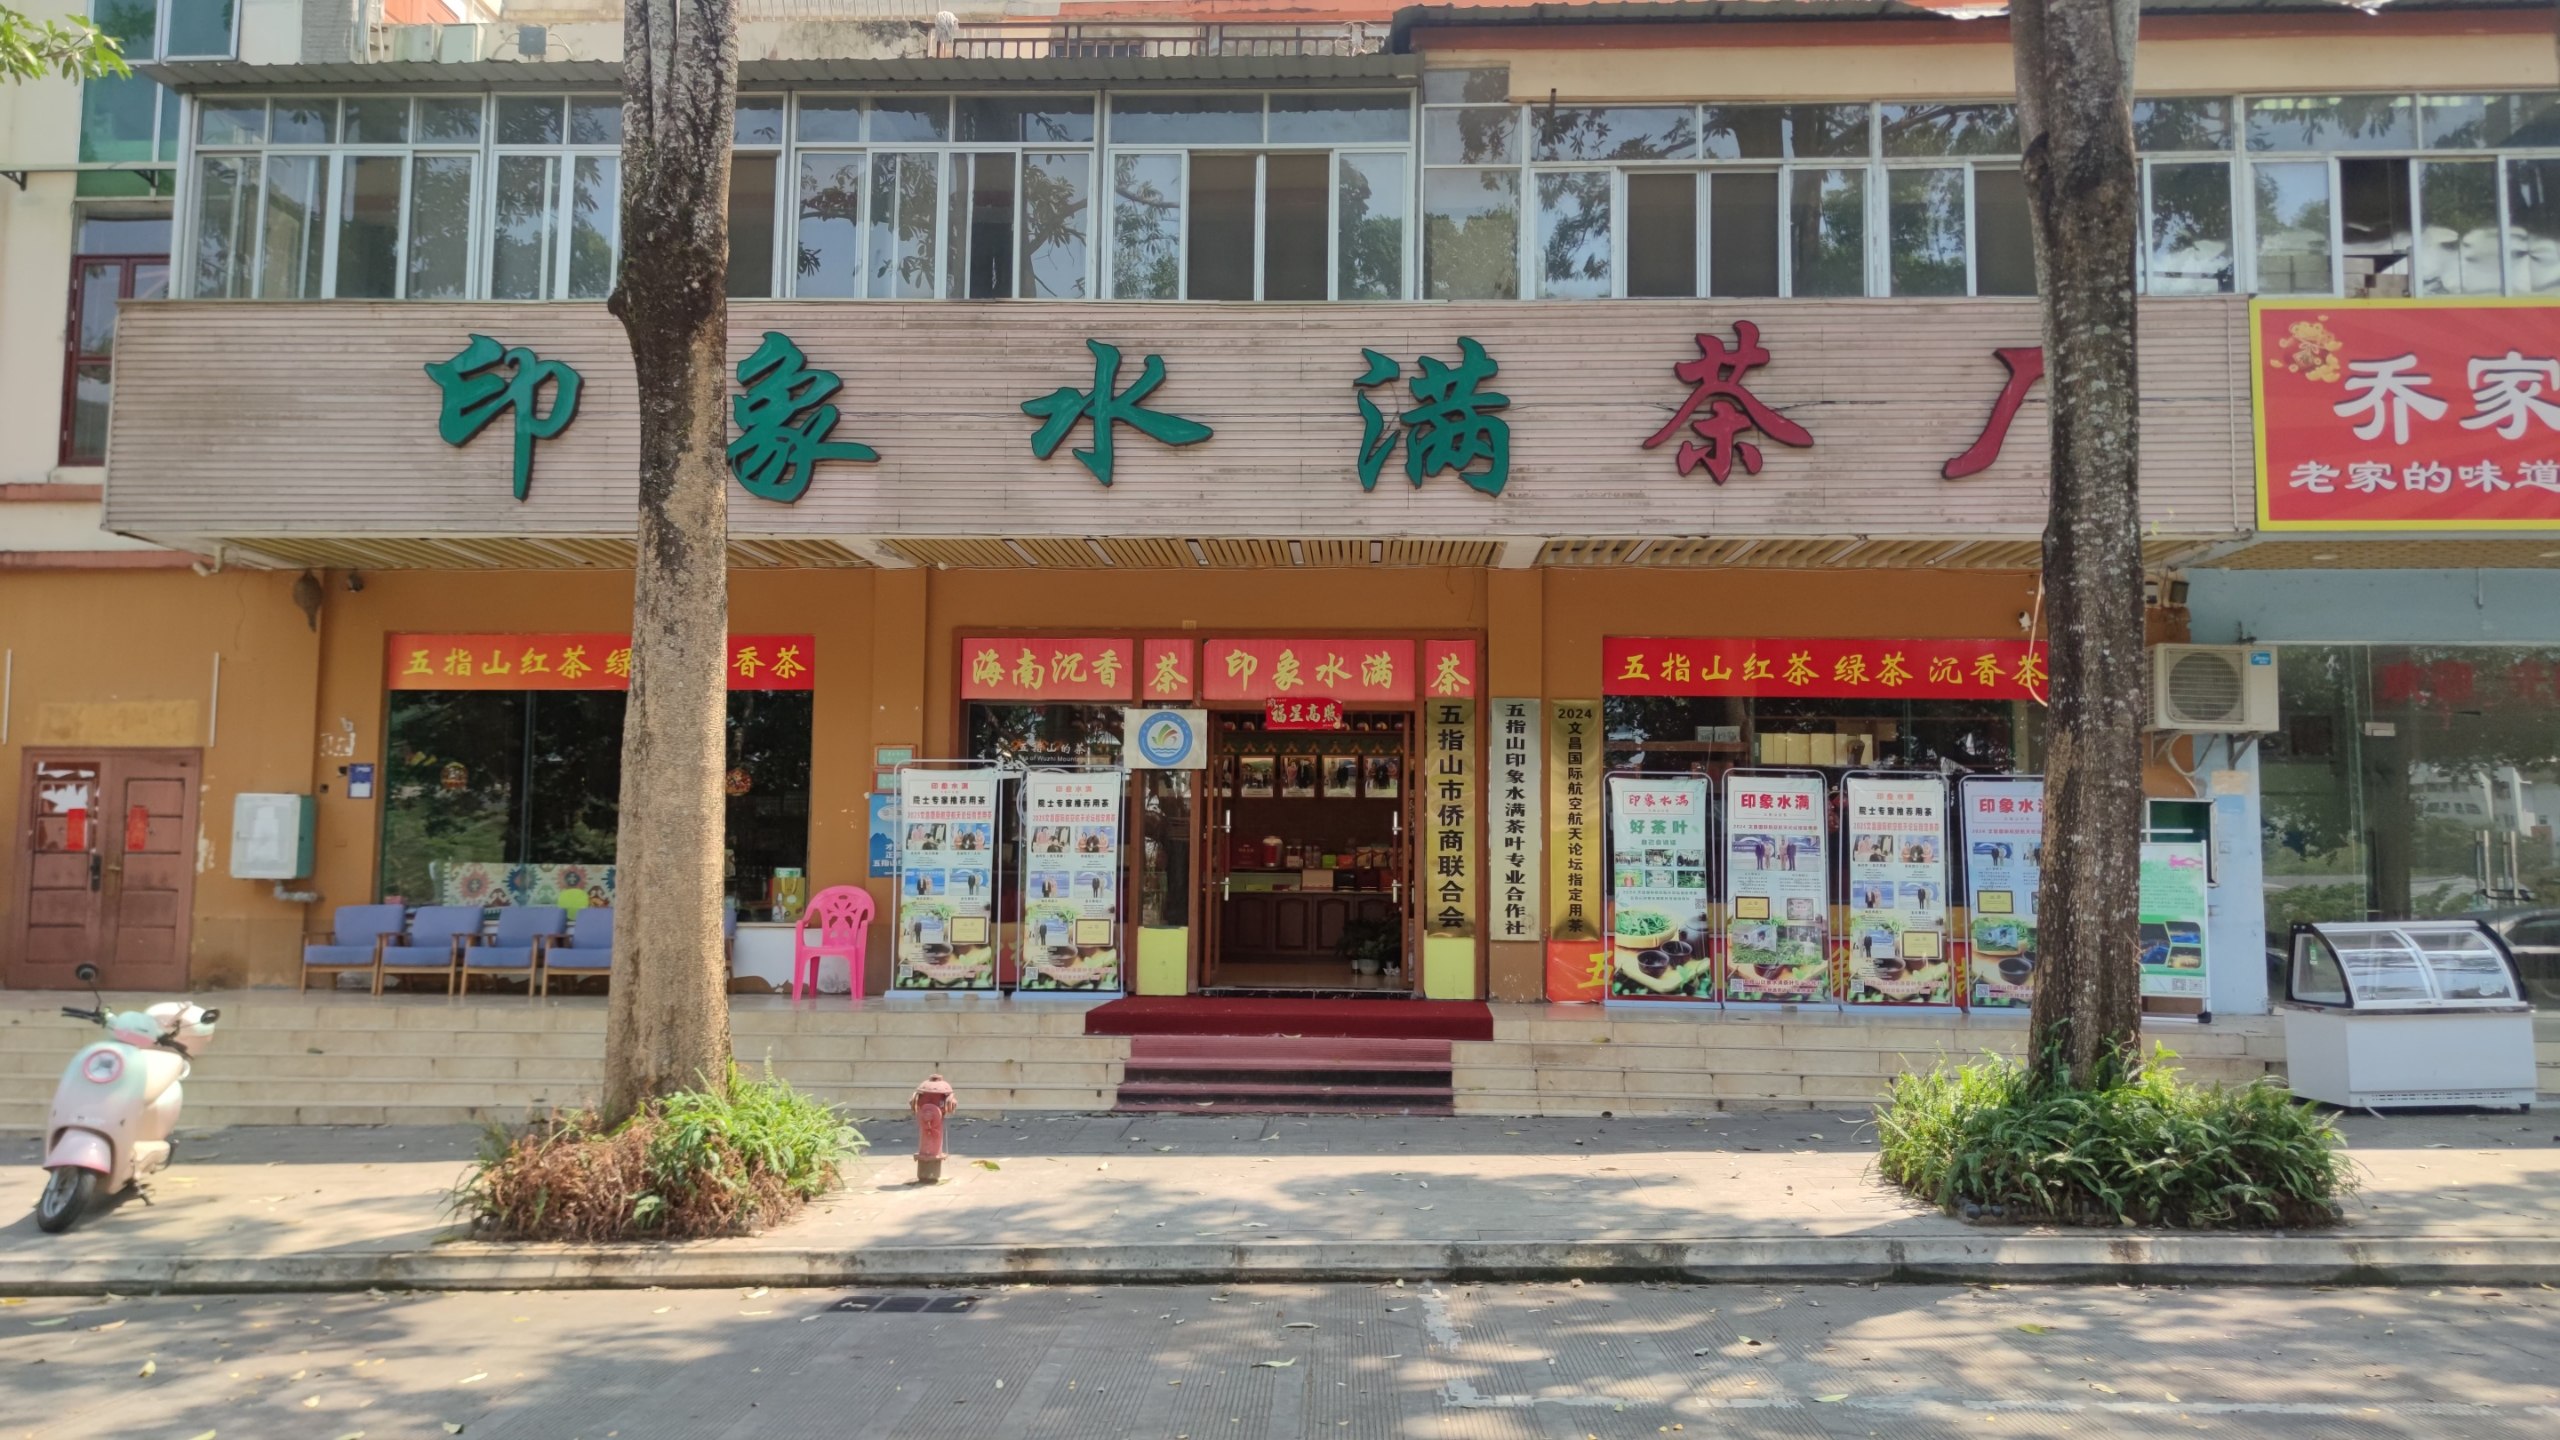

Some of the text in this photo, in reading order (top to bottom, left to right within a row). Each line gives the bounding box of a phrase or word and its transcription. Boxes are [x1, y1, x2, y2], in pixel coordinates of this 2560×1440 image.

[2333, 350, 2560, 445] 乔家
[2289, 460, 2560, 493] 老家的味道
[402, 647, 592, 679] 五指山红茶
[732, 646, 806, 679] 香茶
[973, 648, 1188, 694] 海南沉香 茶
[1225, 649, 1470, 695] 印象水满 茶
[1618, 652, 1820, 686] 五指山红茶
[1833, 651, 1914, 687] 绿茶
[1271, 703, 1337, 724] 福星高照
[1558, 709, 1592, 719] 2024
[912, 796, 985, 805] 院士专家推荐用茶
[1037, 799, 1109, 808] 院士专家推荐用茶
[1437, 705, 1465, 928] 五指山市侨商联合会
[1629, 794, 1689, 807] 印象水满
[1741, 793, 1810, 811] 印象水满
[1858, 806, 1933, 816] 院士专家推荐用茶
[1505, 704, 1527, 935] 五指山印象水满茶叶专业合作社
[1567, 722, 1584, 933] 文昌国际航空航天论坛指定用茶
[1629, 819, 1688, 835] 好茶叶
